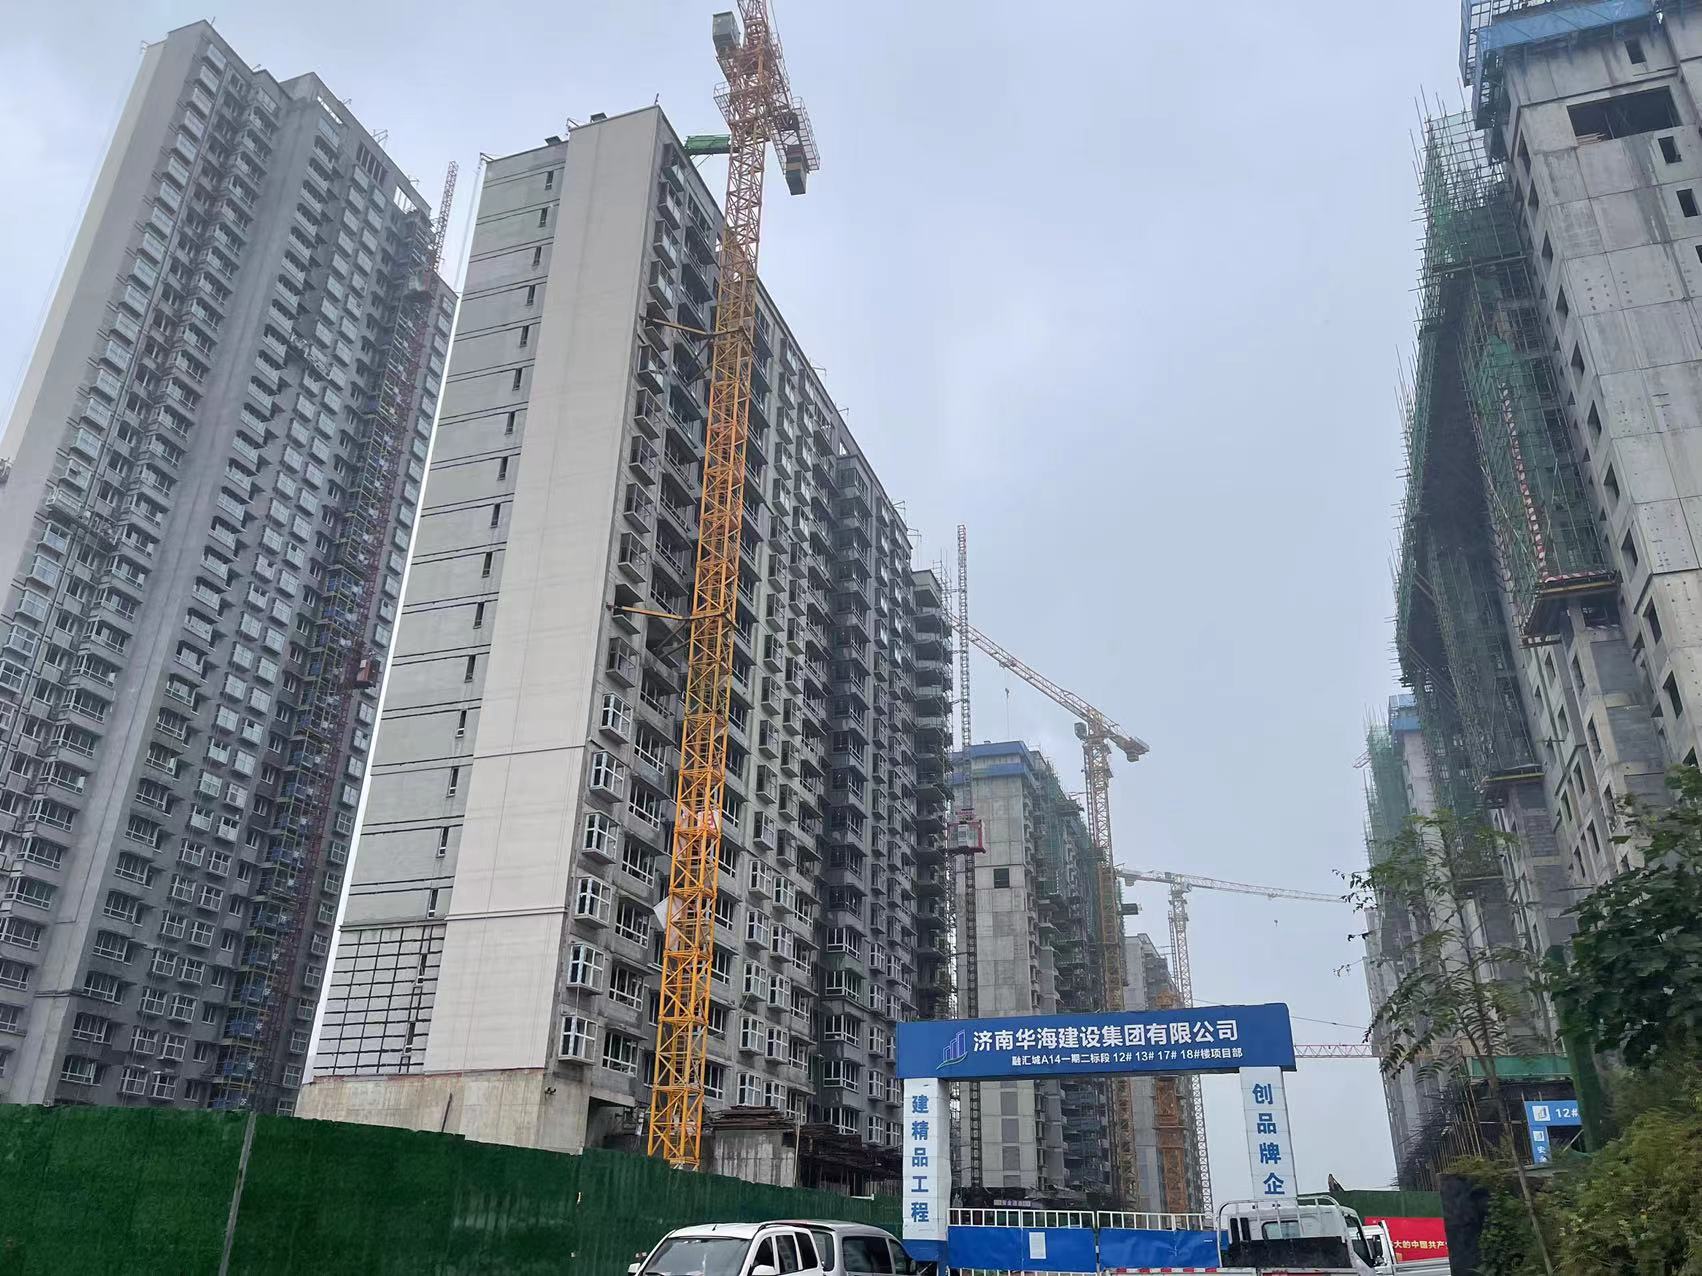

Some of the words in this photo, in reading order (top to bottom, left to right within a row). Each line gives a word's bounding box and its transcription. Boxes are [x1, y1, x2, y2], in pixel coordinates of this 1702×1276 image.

[973, 1019, 1238, 1052] 济南华海建设集团有限公司
[1113, 1052, 1132, 1062] 12#
[1135, 1051, 1155, 1061] 13#
[1158, 1050, 1177, 1060] 17#
[1180, 1047, 1243, 1060] 18#楼项目部
[911, 1094, 929, 1222] 建精品工程
[1252, 1083, 1285, 1195] 创品牌企
